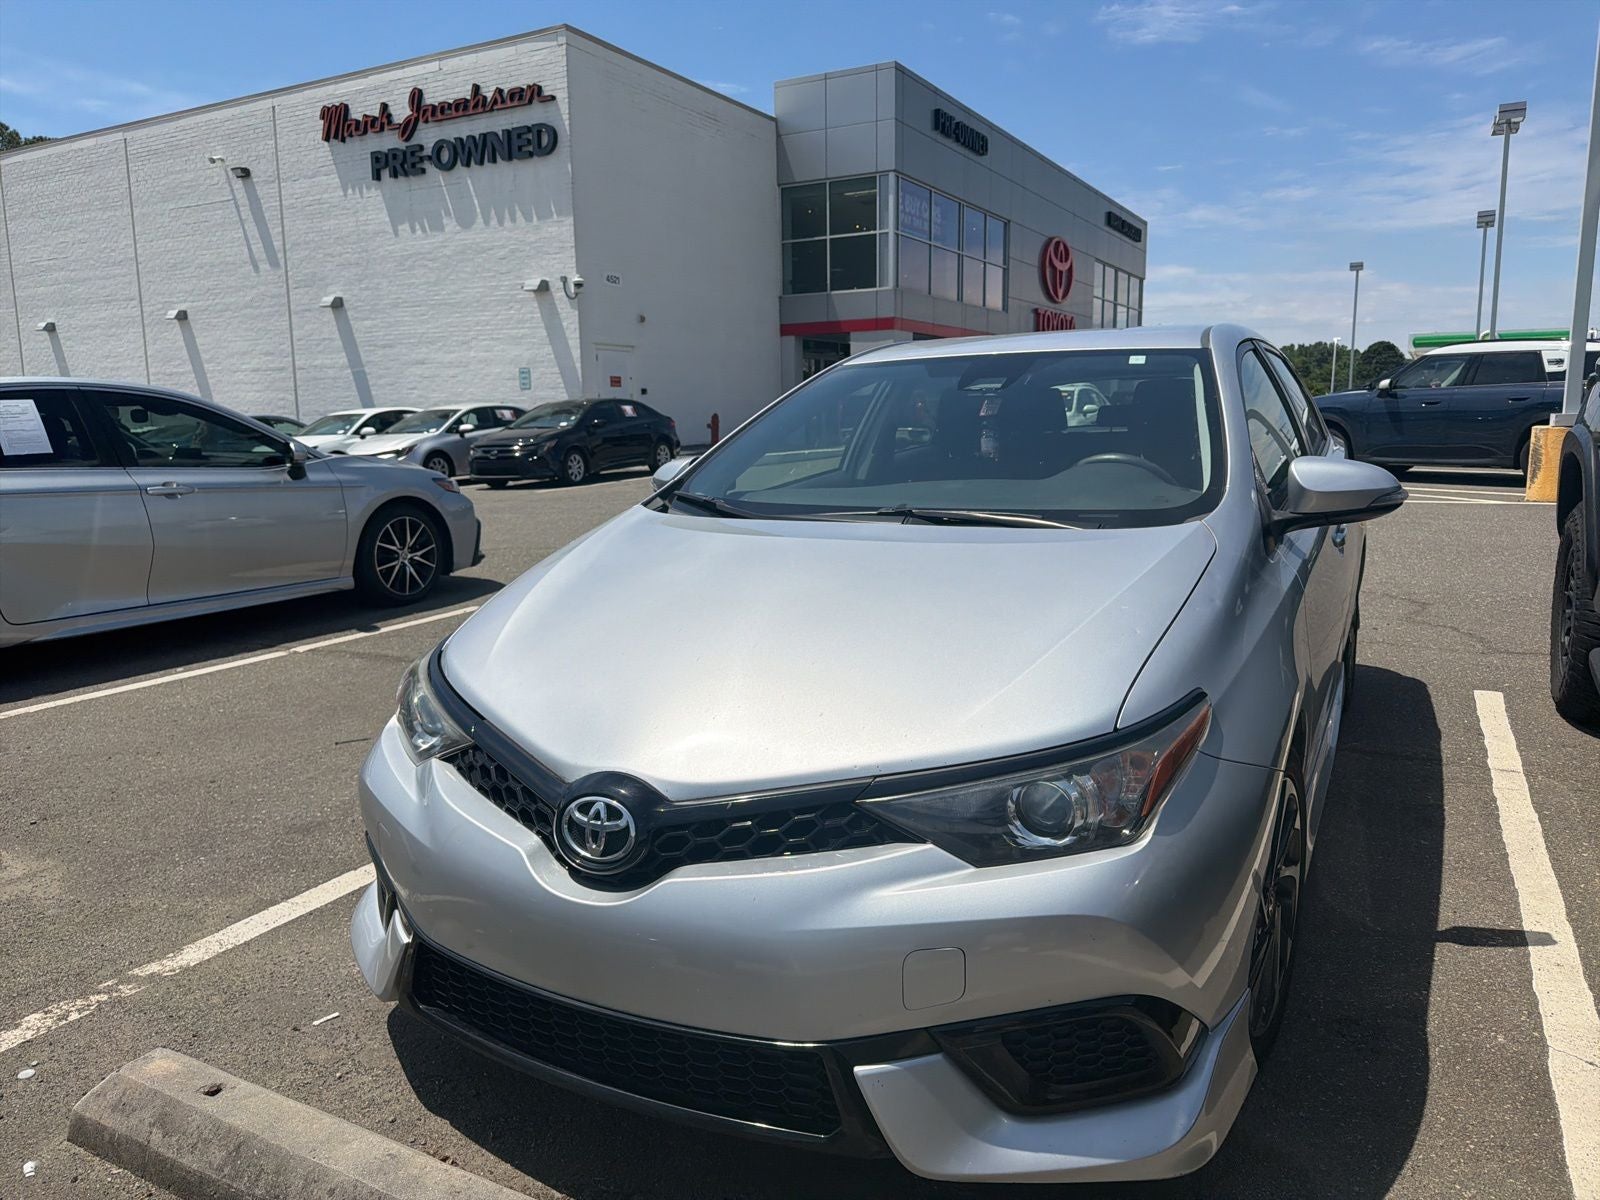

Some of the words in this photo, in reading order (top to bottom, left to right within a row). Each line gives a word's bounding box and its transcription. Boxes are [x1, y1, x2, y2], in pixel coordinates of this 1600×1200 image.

[320, 101, 400, 143] Mark
[397, 83, 556, 143] Jacobson
[933, 108, 988, 157] PRE-OWNED
[370, 122, 558, 181] PRE-OWNED
